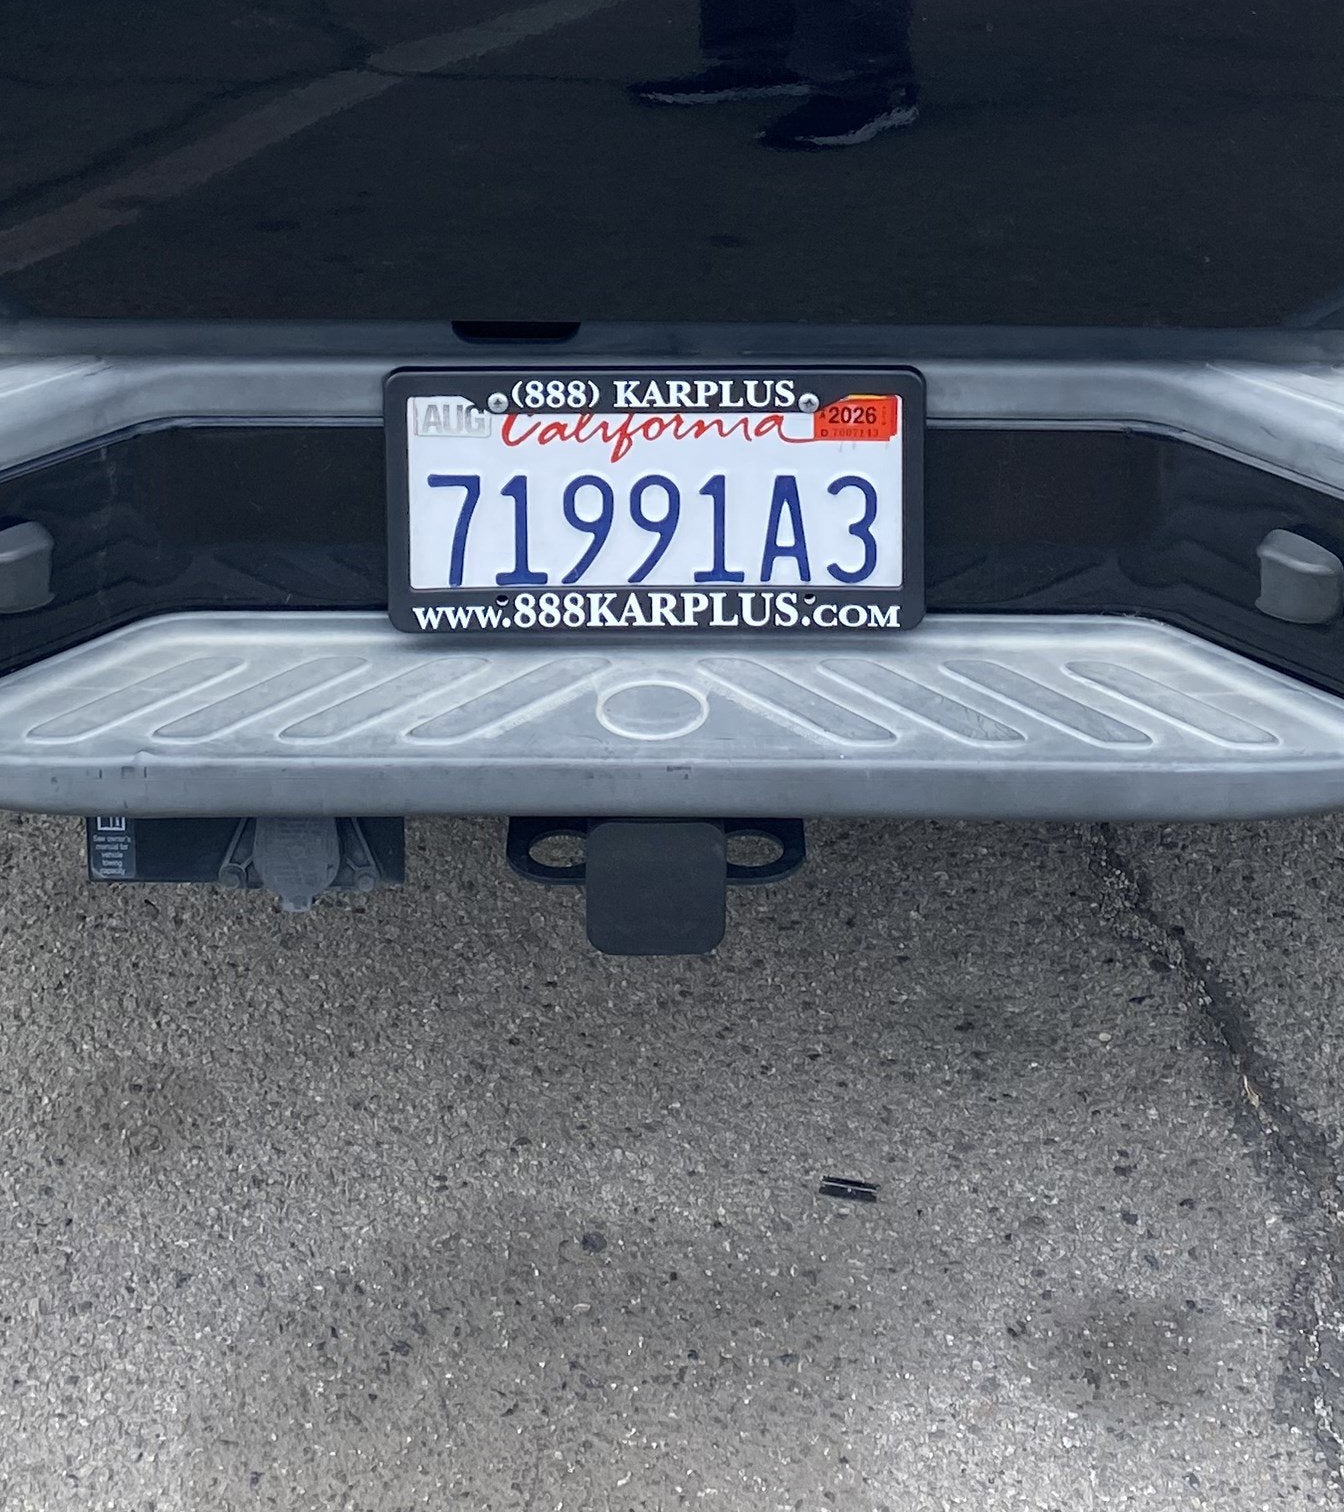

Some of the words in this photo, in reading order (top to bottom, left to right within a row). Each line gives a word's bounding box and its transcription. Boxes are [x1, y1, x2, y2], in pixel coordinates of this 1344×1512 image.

[511, 380, 600, 409] (888)
[613, 380, 796, 408] KARPLUS
[422, 404, 486, 434] AUG
[828, 406, 877, 424] 2026
[501, 412, 814, 463] California
[427, 474, 878, 586] 71991A3
